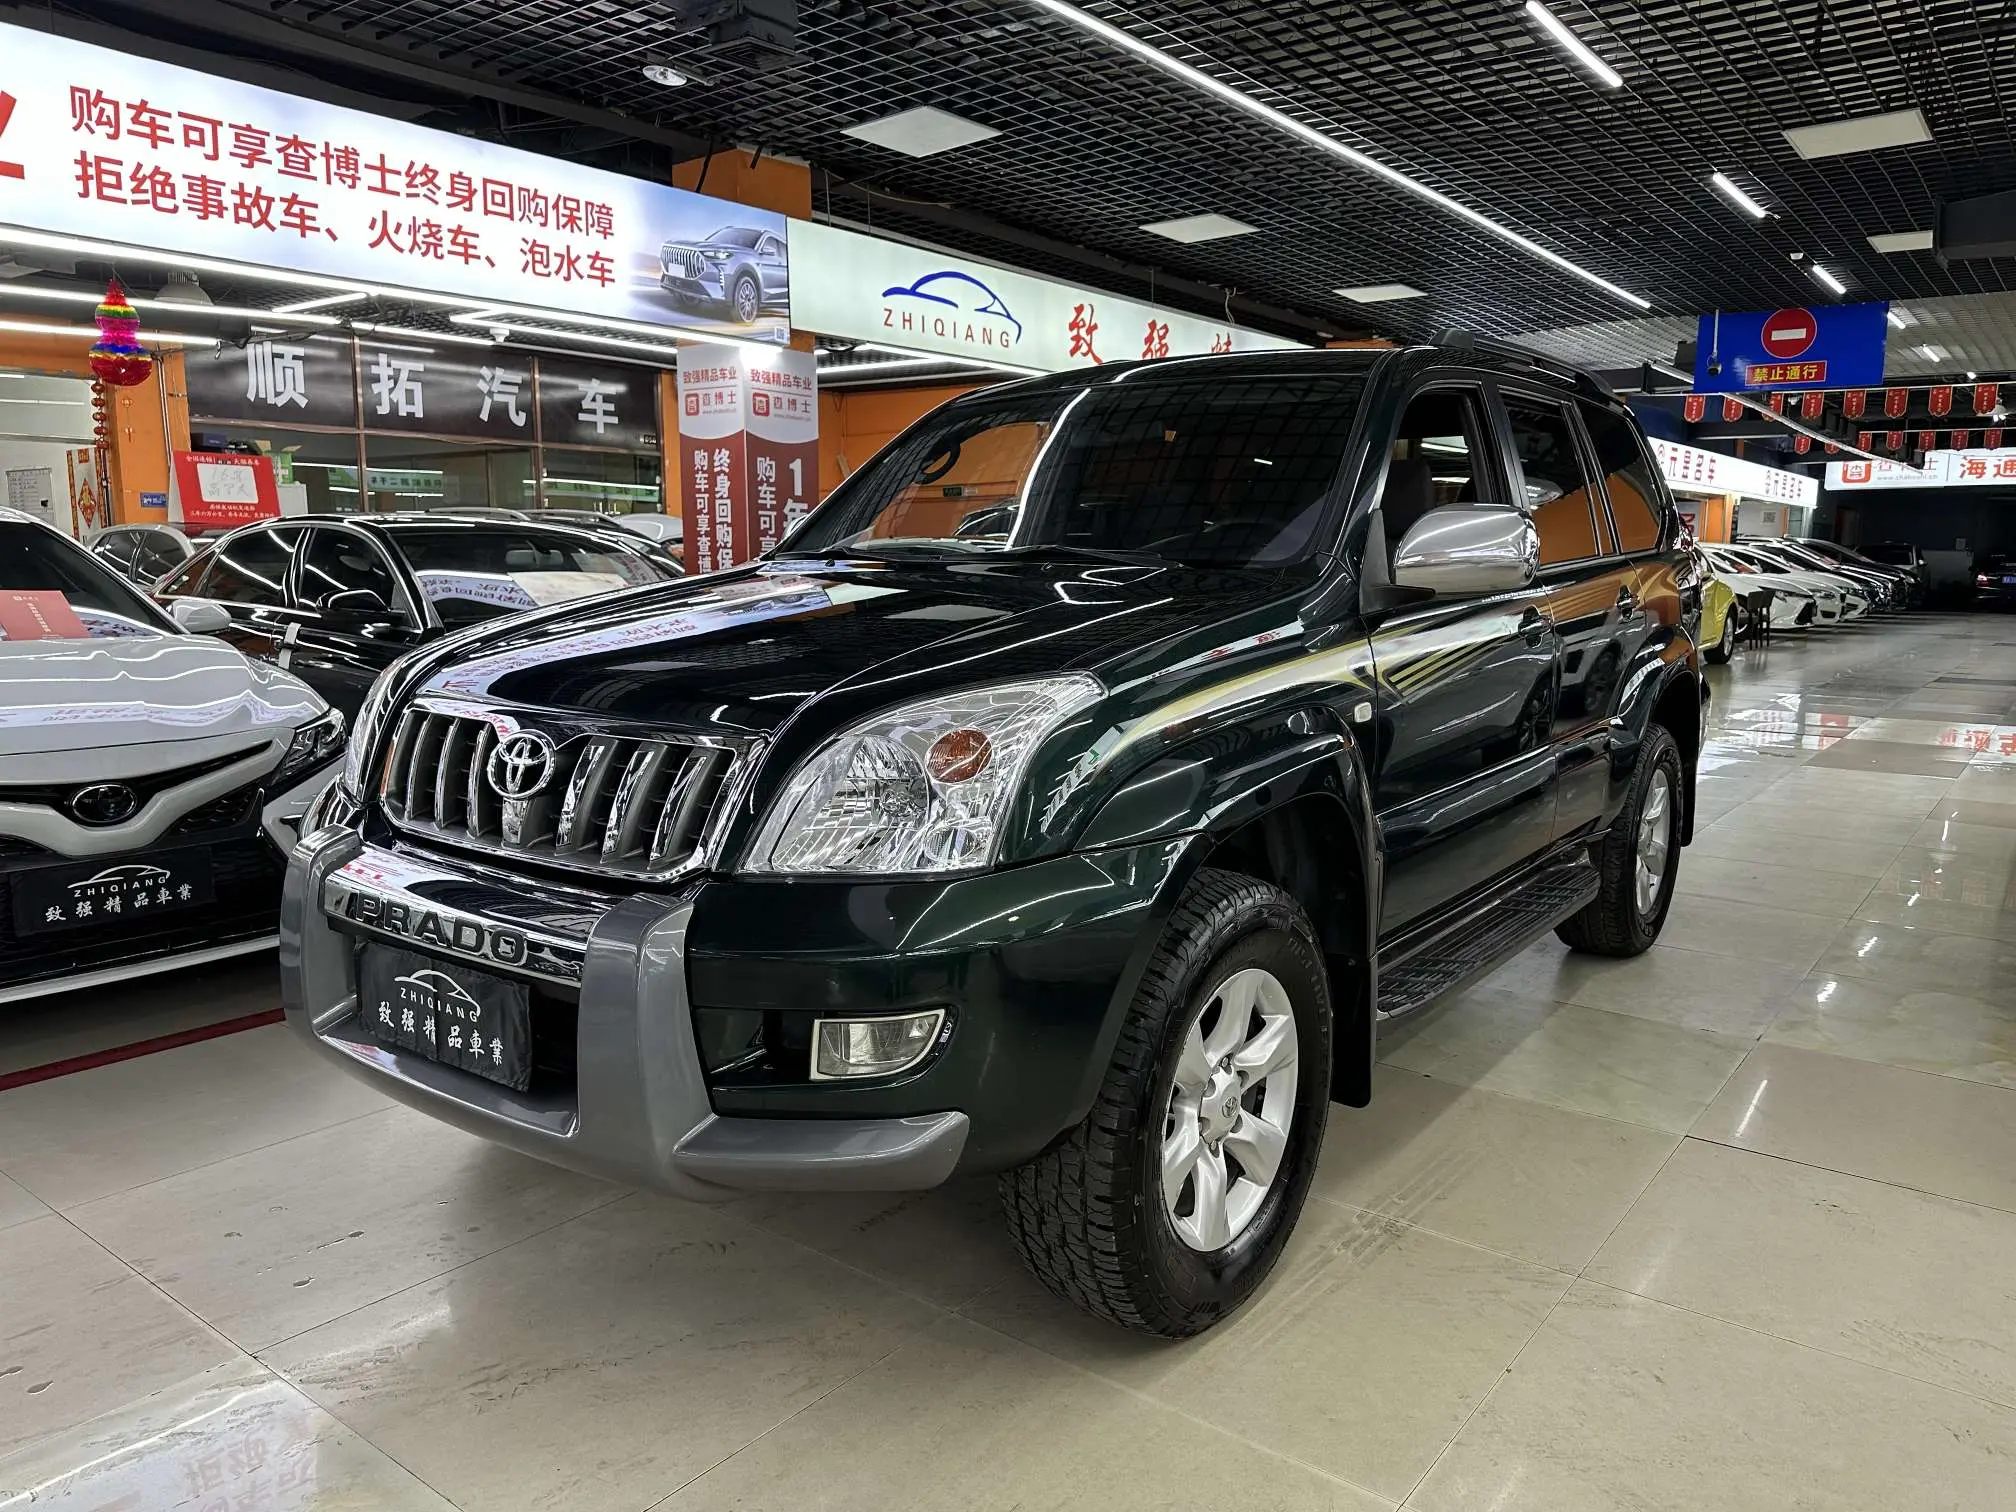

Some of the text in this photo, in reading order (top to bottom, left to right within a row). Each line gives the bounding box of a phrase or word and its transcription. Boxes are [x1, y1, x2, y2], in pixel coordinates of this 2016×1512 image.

[70, 85, 615, 240] 购车可享查博士终身回购保障
[74, 150, 616, 288] 拒绝事故车、火烧车、泡水车
[883, 308, 1010, 349] ZHIQIANG
[246, 341, 620, 434] 顺拓汽车
[683, 366, 737, 385] 致强精品车业
[750, 368, 812, 391] 致强精品车业
[1753, 364, 1818, 382] 禁止通行
[1878, 457, 1939, 472] 查士
[1959, 456, 2016, 479] 海通
[713, 448, 733, 570] 终身回购保
[45, 883, 193, 922] 致强精品車業
[74, 876, 167, 898] ZHIQIANG
[353, 891, 529, 967] PRADO
[400, 987, 478, 1023] ZHIQIANG
[379, 1001, 504, 1067] 致强精品車業
